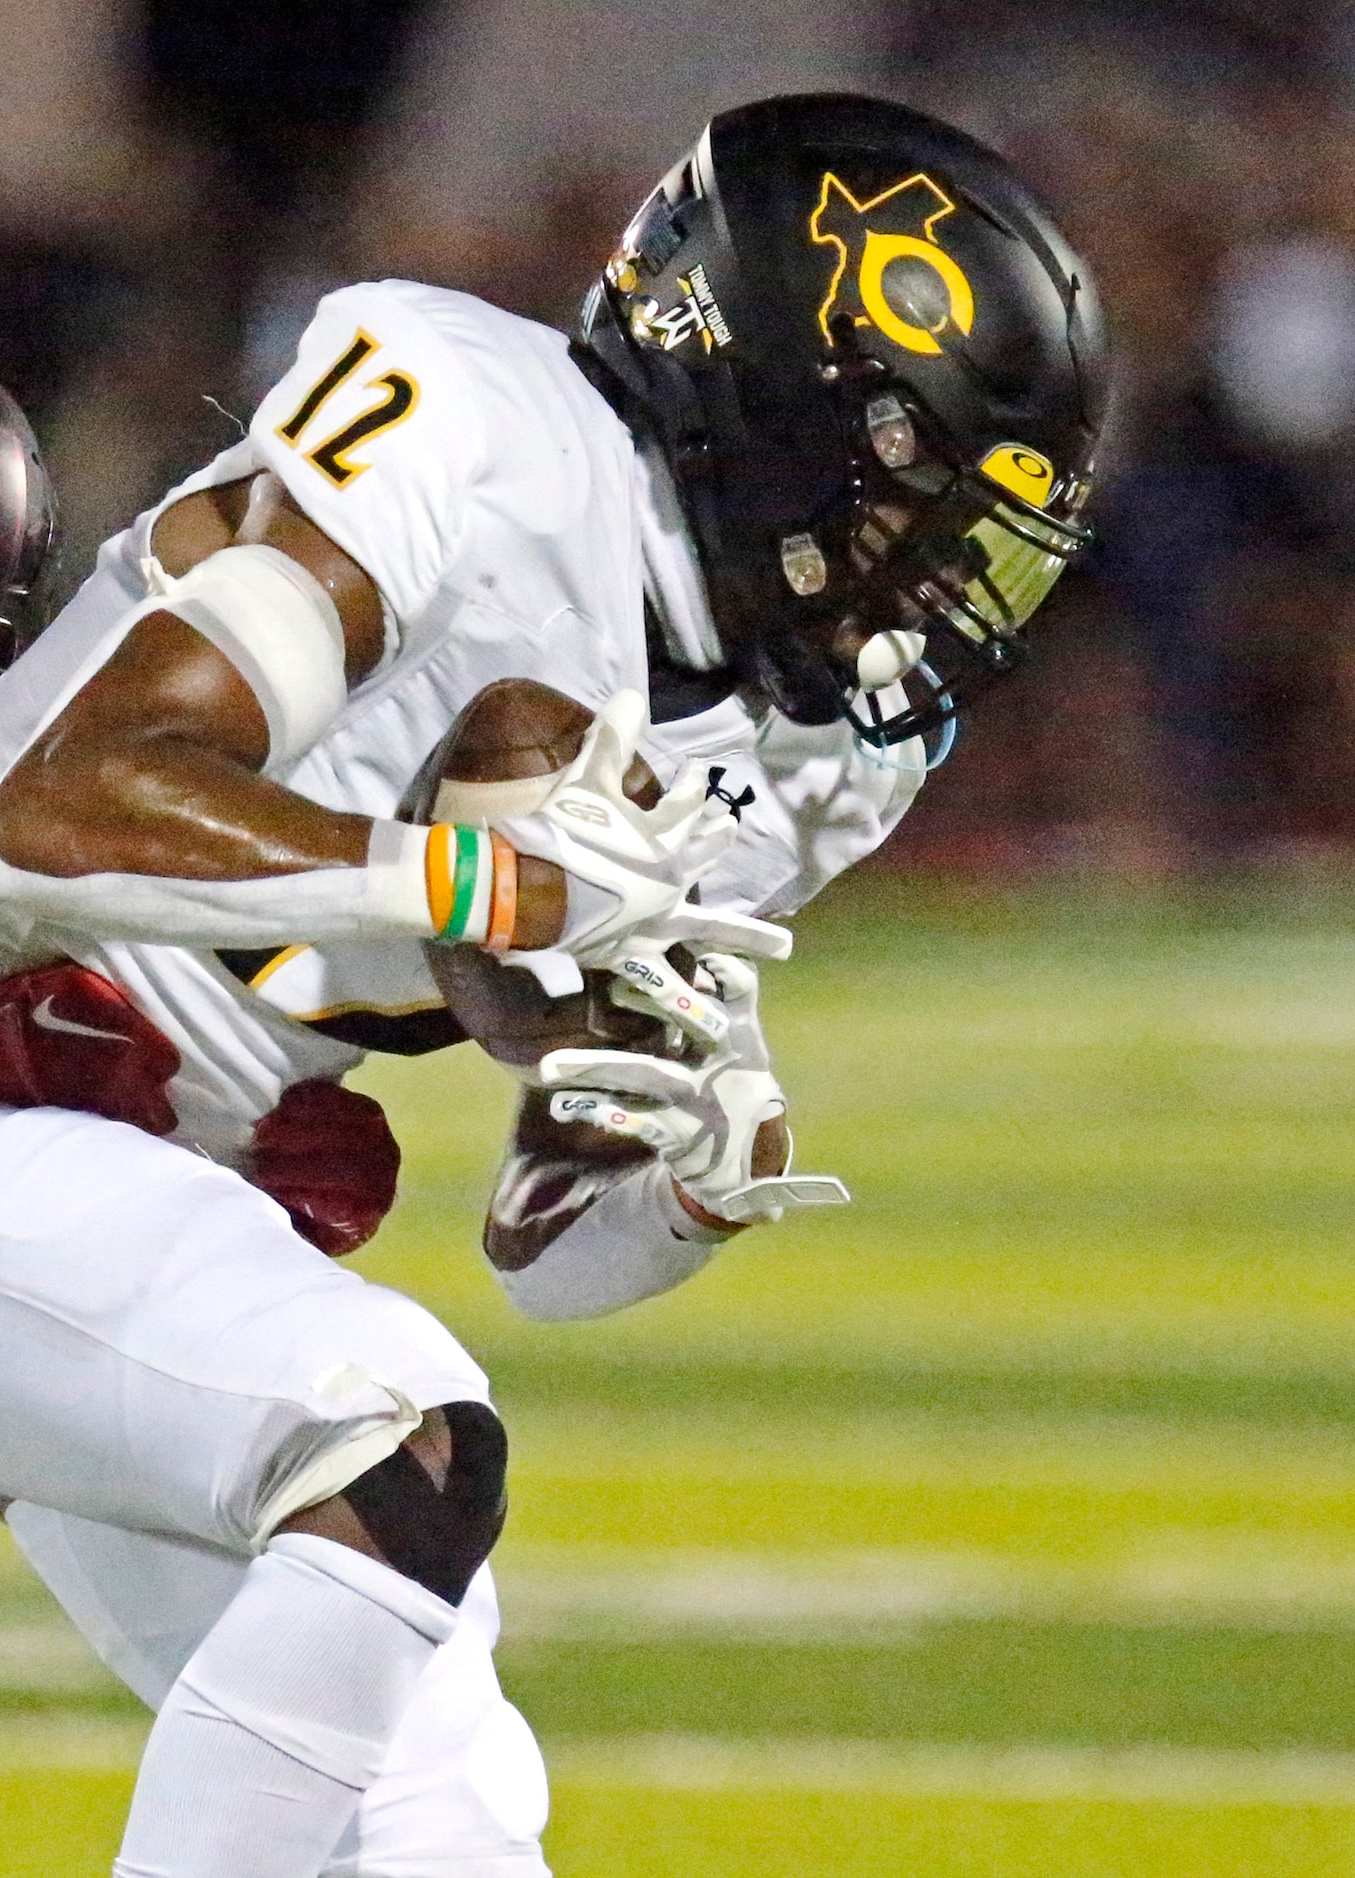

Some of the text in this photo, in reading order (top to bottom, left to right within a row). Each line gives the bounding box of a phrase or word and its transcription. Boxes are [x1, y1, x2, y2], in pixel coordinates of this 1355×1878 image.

[689, 263, 733, 347] TOMMY TOUGH
[274, 326, 421, 491] 12
[625, 960, 664, 988] GRIP
